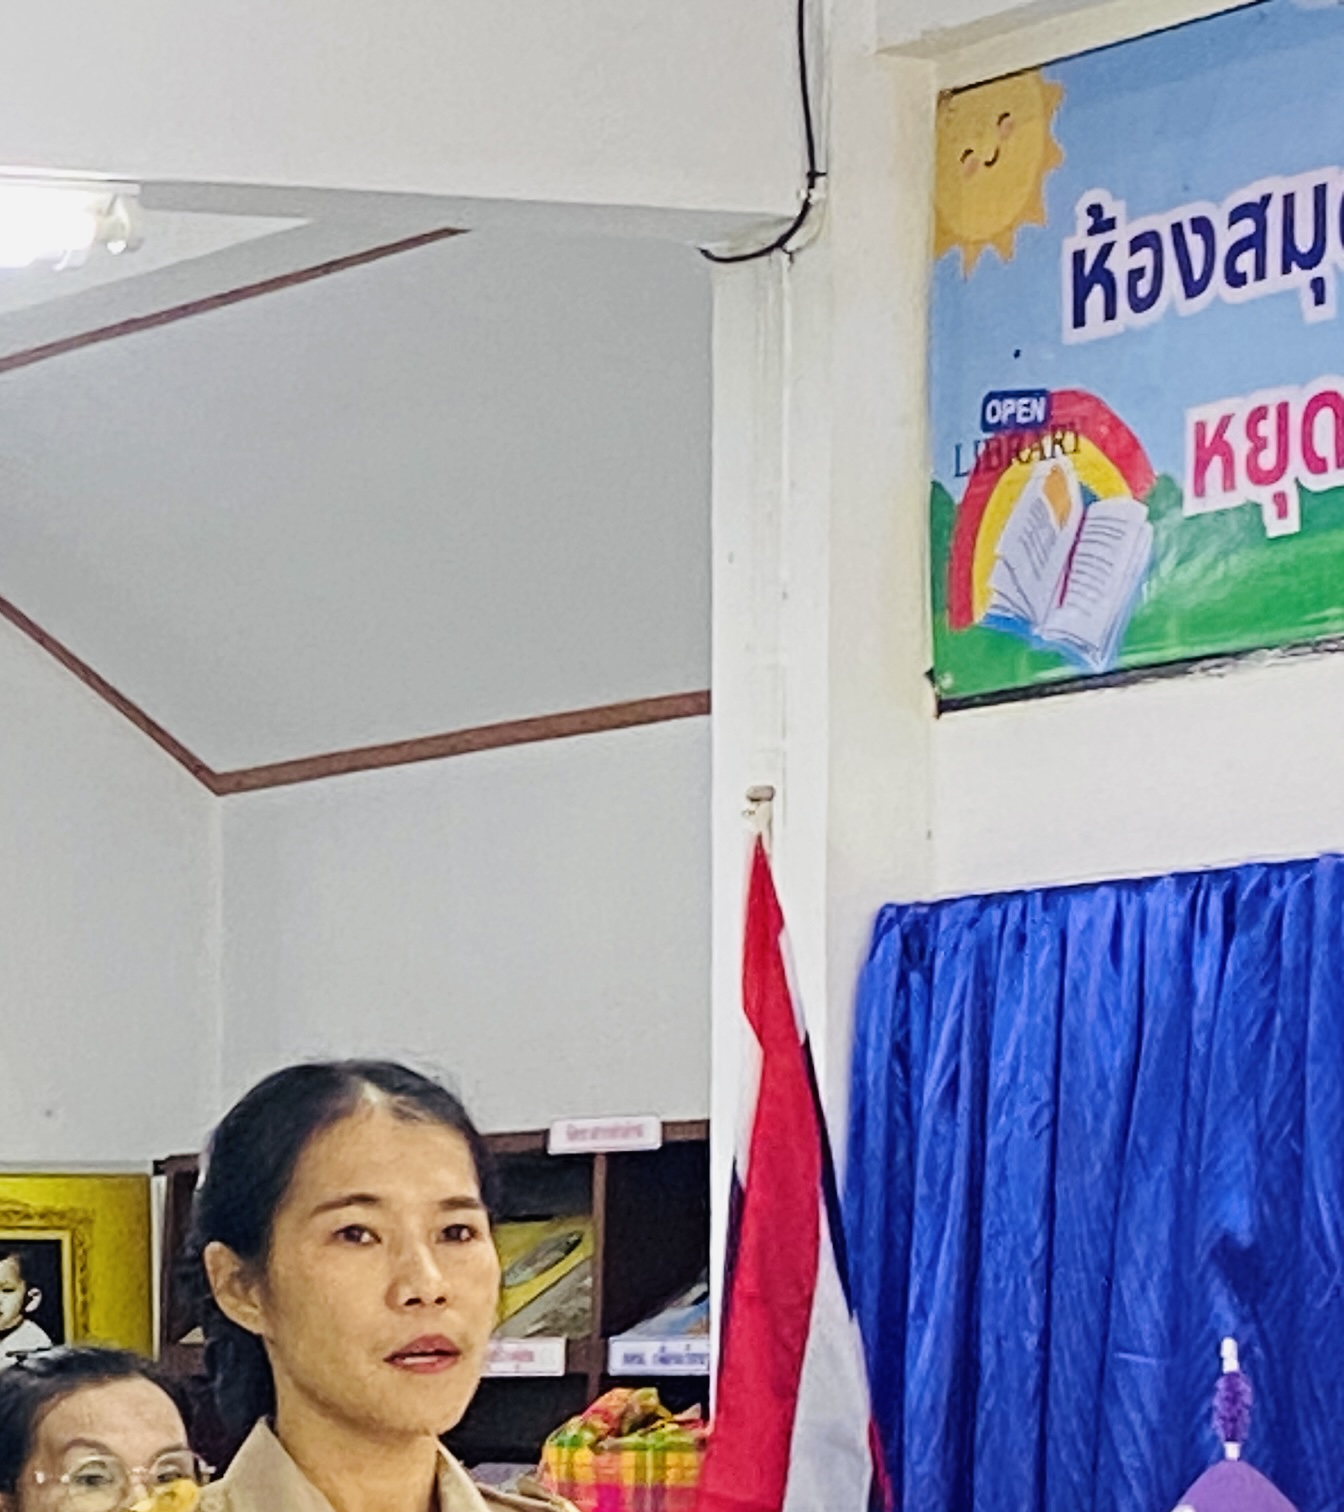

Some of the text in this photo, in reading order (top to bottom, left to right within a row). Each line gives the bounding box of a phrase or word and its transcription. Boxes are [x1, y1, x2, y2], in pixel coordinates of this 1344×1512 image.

[1070, 182, 1344, 330] ห้องสมุ
[984, 396, 1047, 424] OPEN
[954, 424, 1081, 478] LIBRARY
